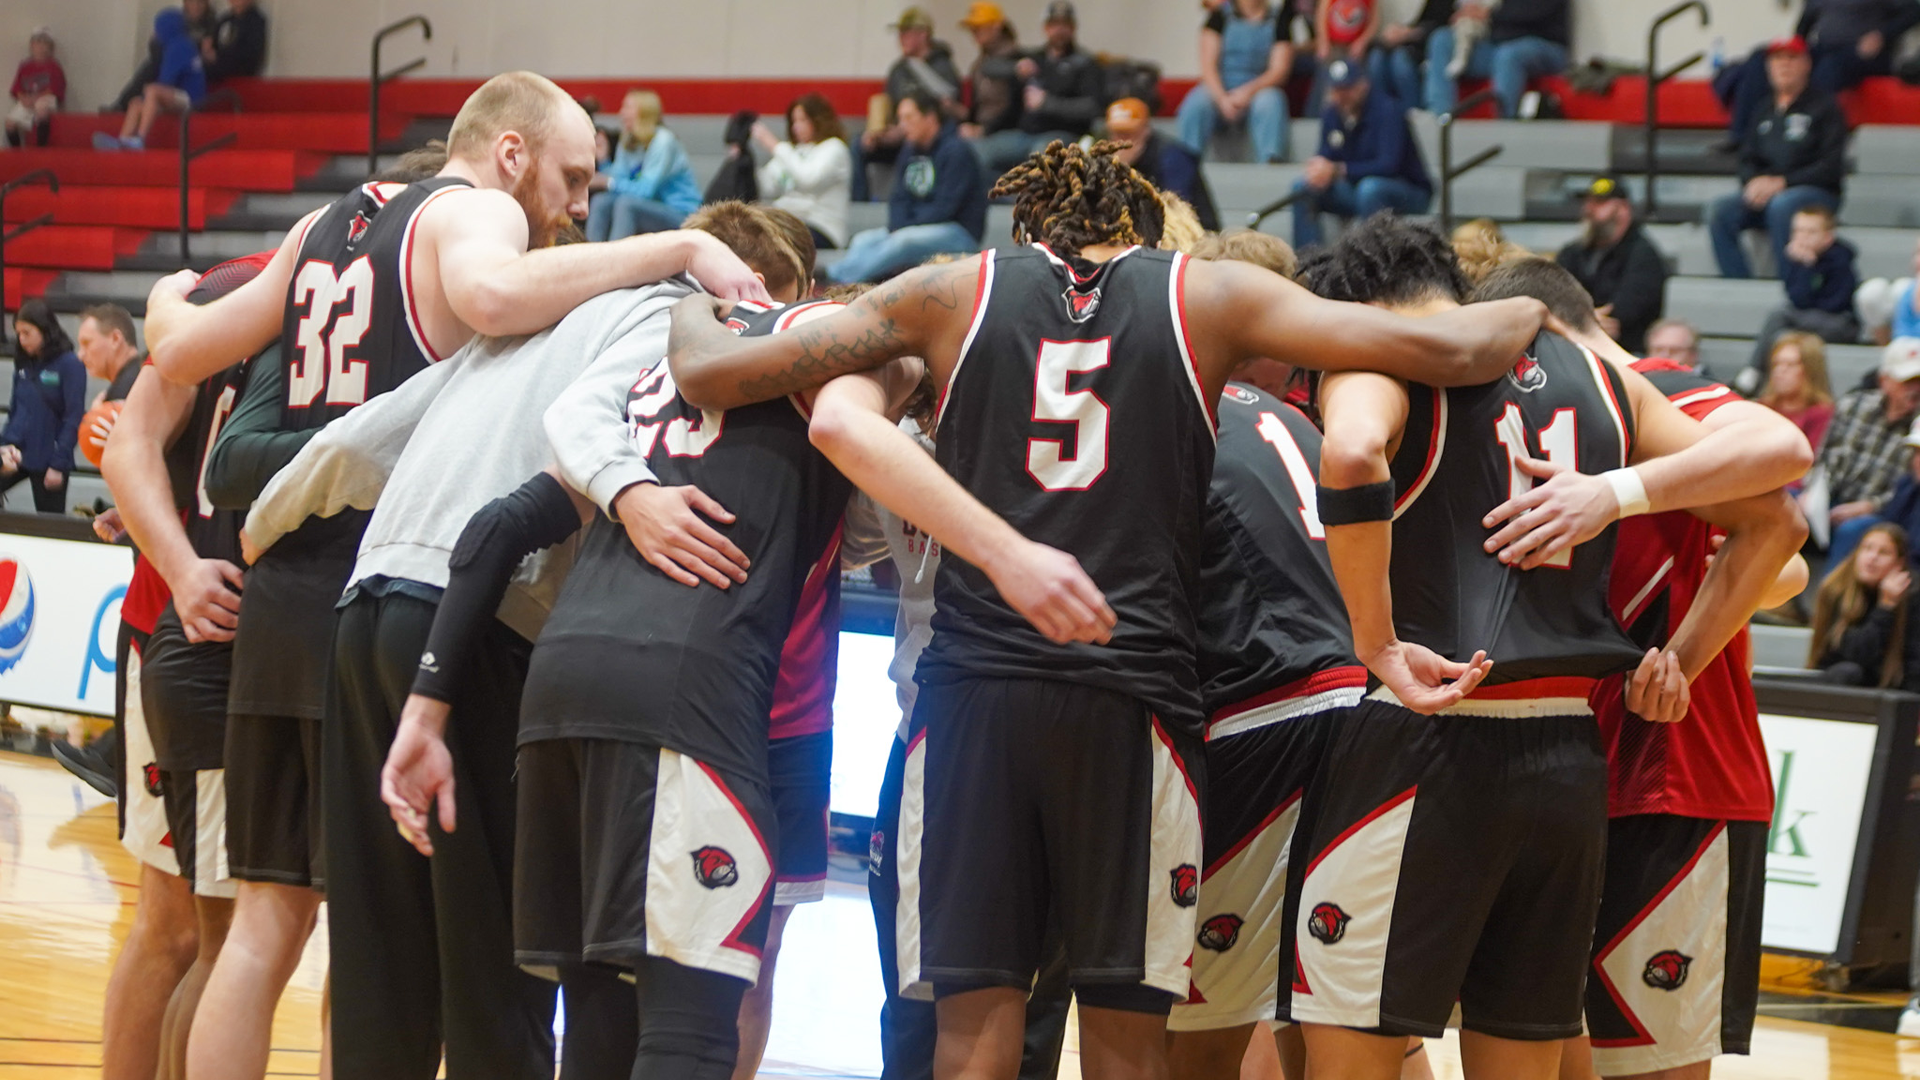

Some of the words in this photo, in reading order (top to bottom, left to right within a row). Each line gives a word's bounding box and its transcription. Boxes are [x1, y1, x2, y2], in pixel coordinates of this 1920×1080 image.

[288, 253, 375, 408] 32
[1025, 335, 1111, 492] 5
[1255, 411, 1326, 540] 1
[1494, 401, 1578, 569] 11
